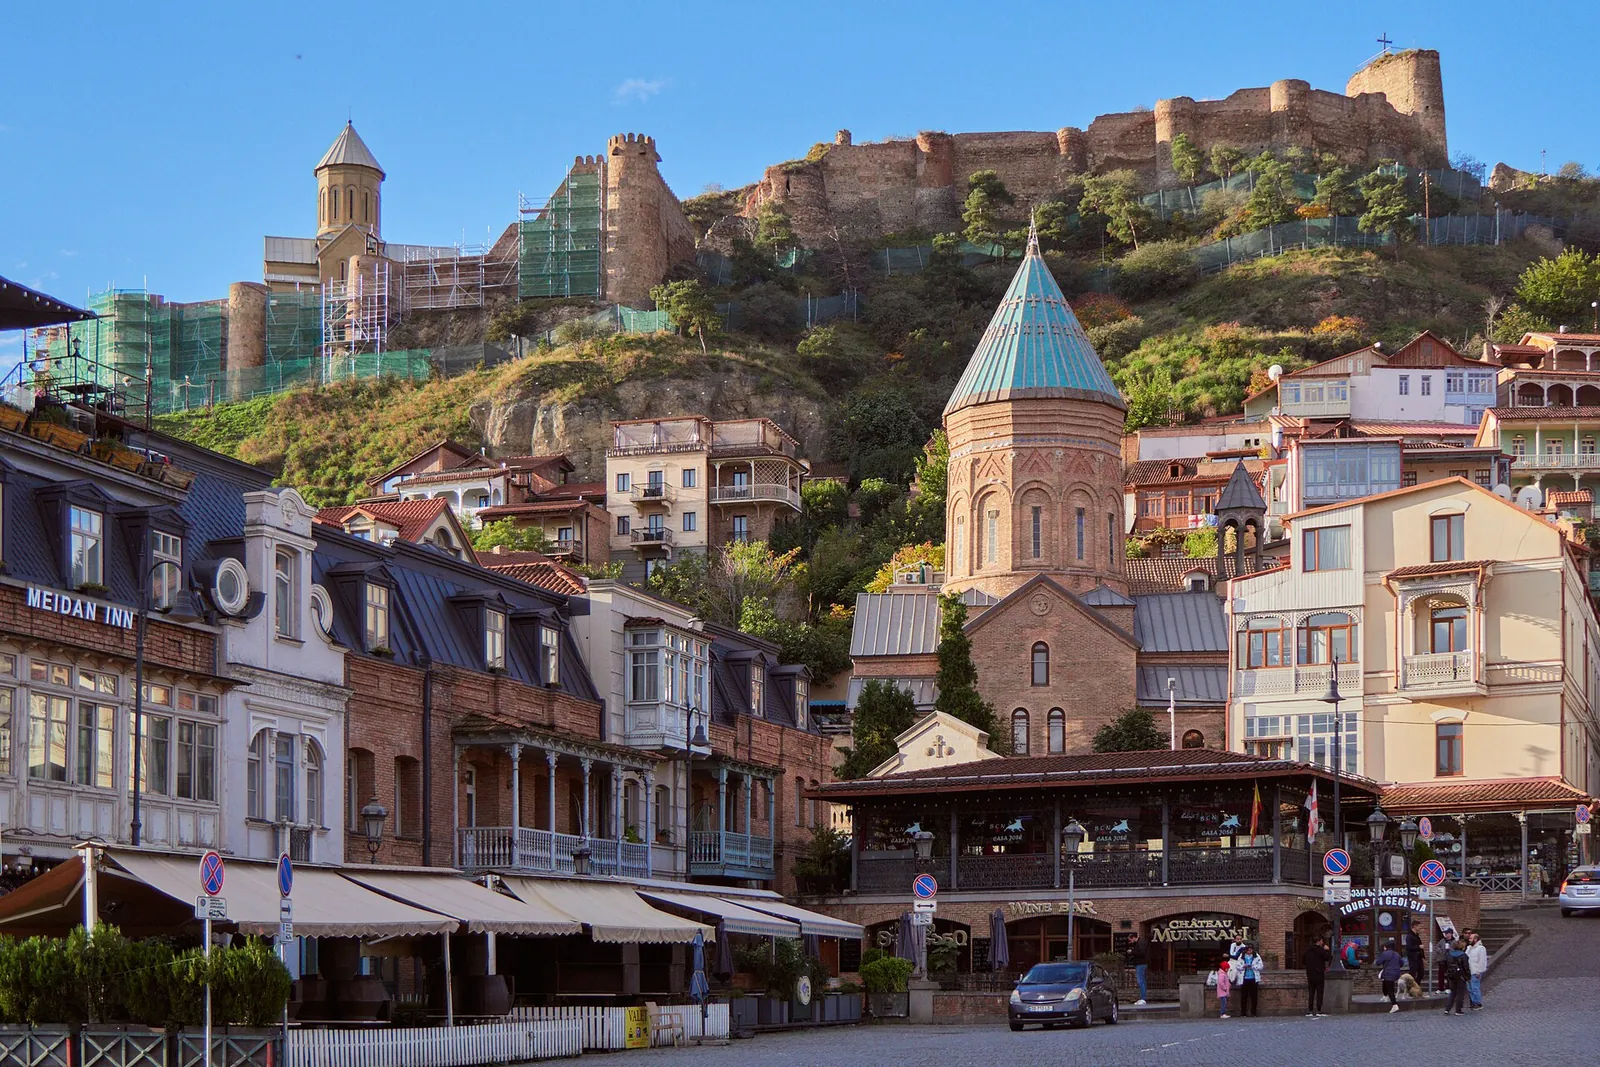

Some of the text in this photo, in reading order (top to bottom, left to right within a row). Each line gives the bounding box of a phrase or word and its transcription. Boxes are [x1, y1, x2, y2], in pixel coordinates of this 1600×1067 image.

[27, 587, 134, 630] MEIDAN INN
[1008, 900, 1098, 916] WINE BAR
[1340, 898, 1371, 915] TOURS
[1168, 917, 1233, 929] CHÂTEAU
[1151, 926, 1249, 943] MUKHRANI
[627, 1009, 648, 1022] VALET
